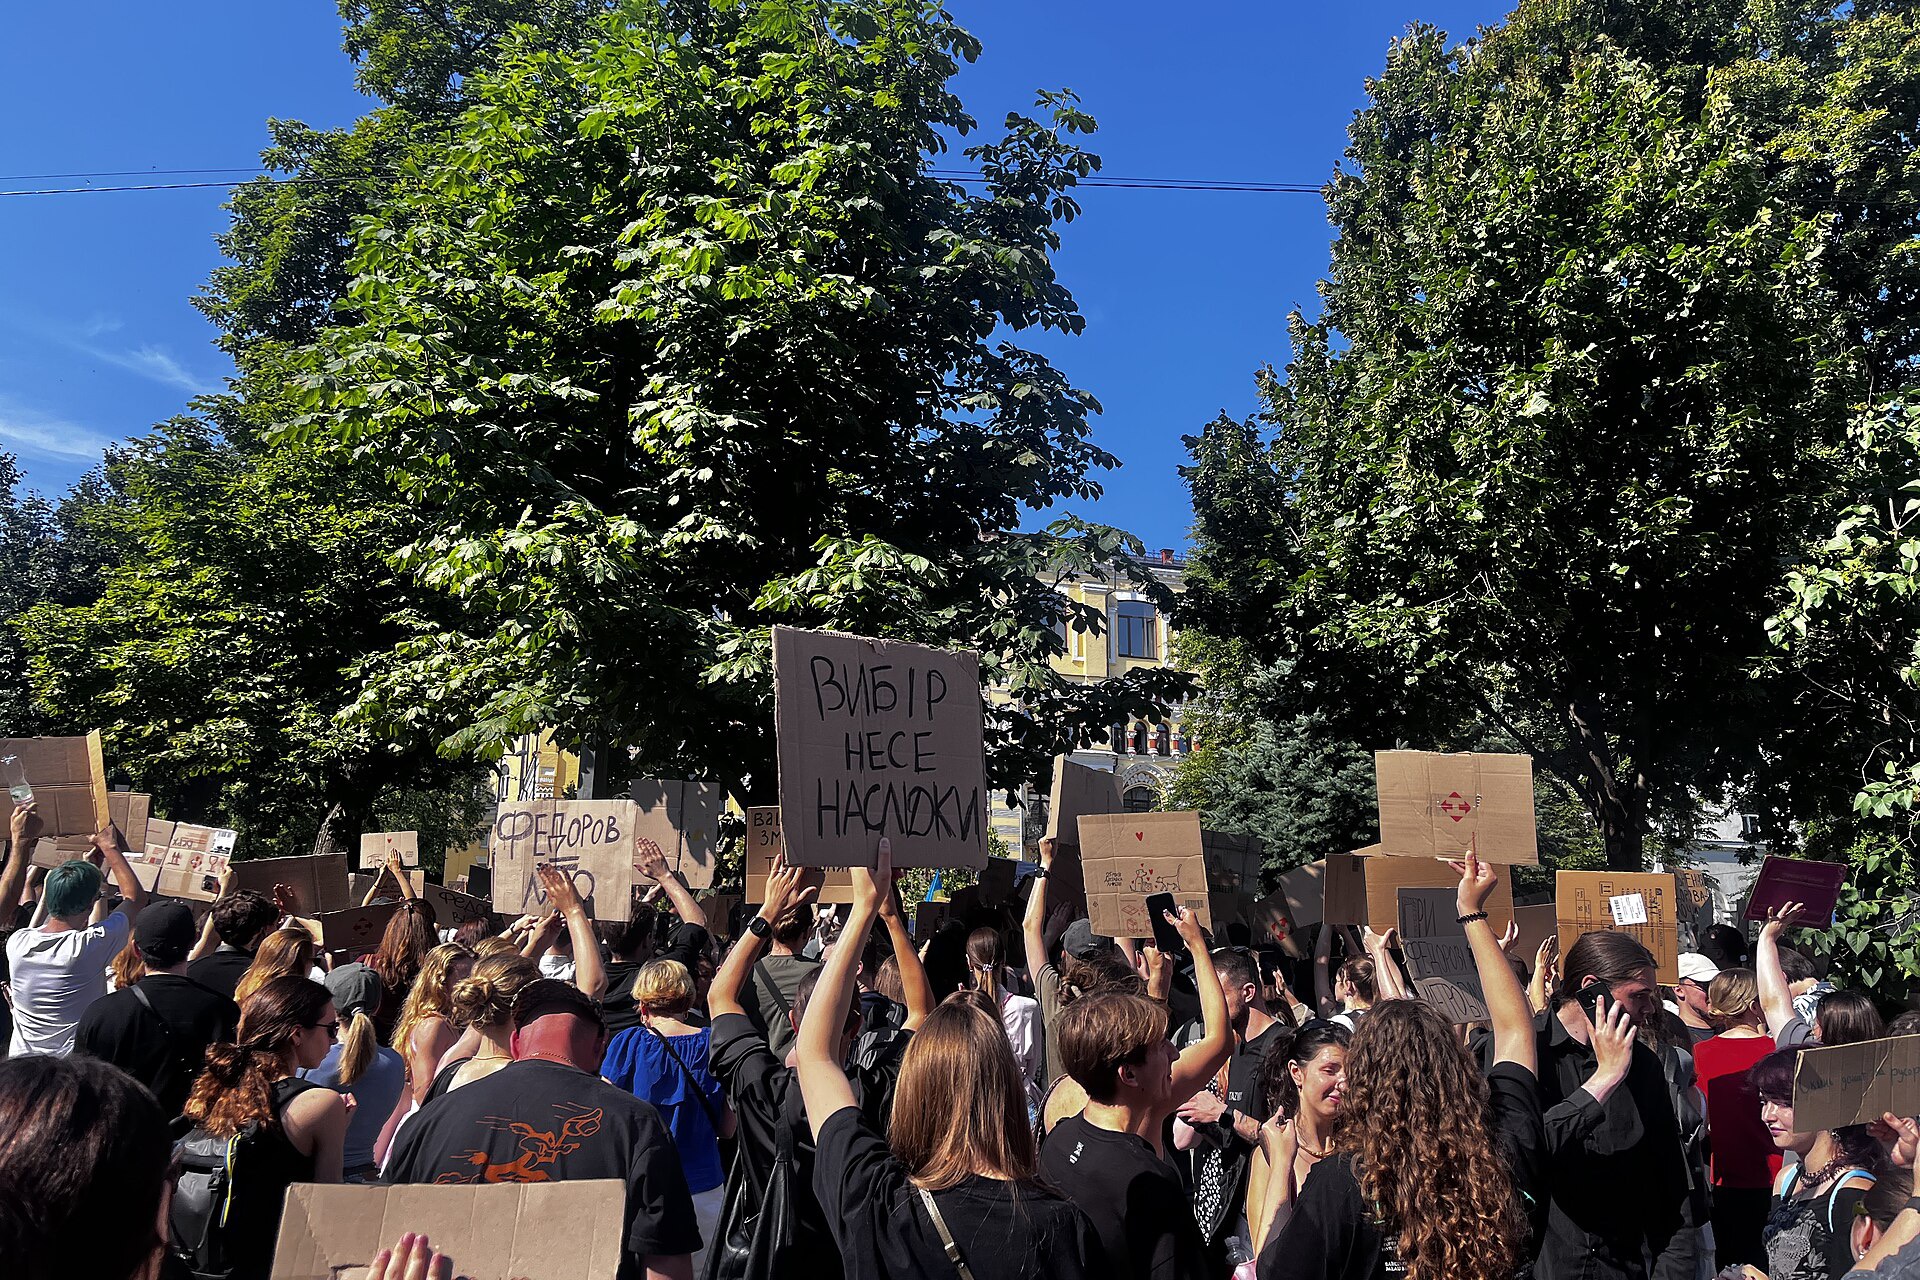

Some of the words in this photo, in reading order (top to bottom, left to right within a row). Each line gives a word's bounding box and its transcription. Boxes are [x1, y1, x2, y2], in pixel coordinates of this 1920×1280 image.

[810, 655, 947, 721] ВИБІР
[844, 731, 936, 775] НЕСЕ
[497, 810, 621, 860] ФЕДОРОВ
